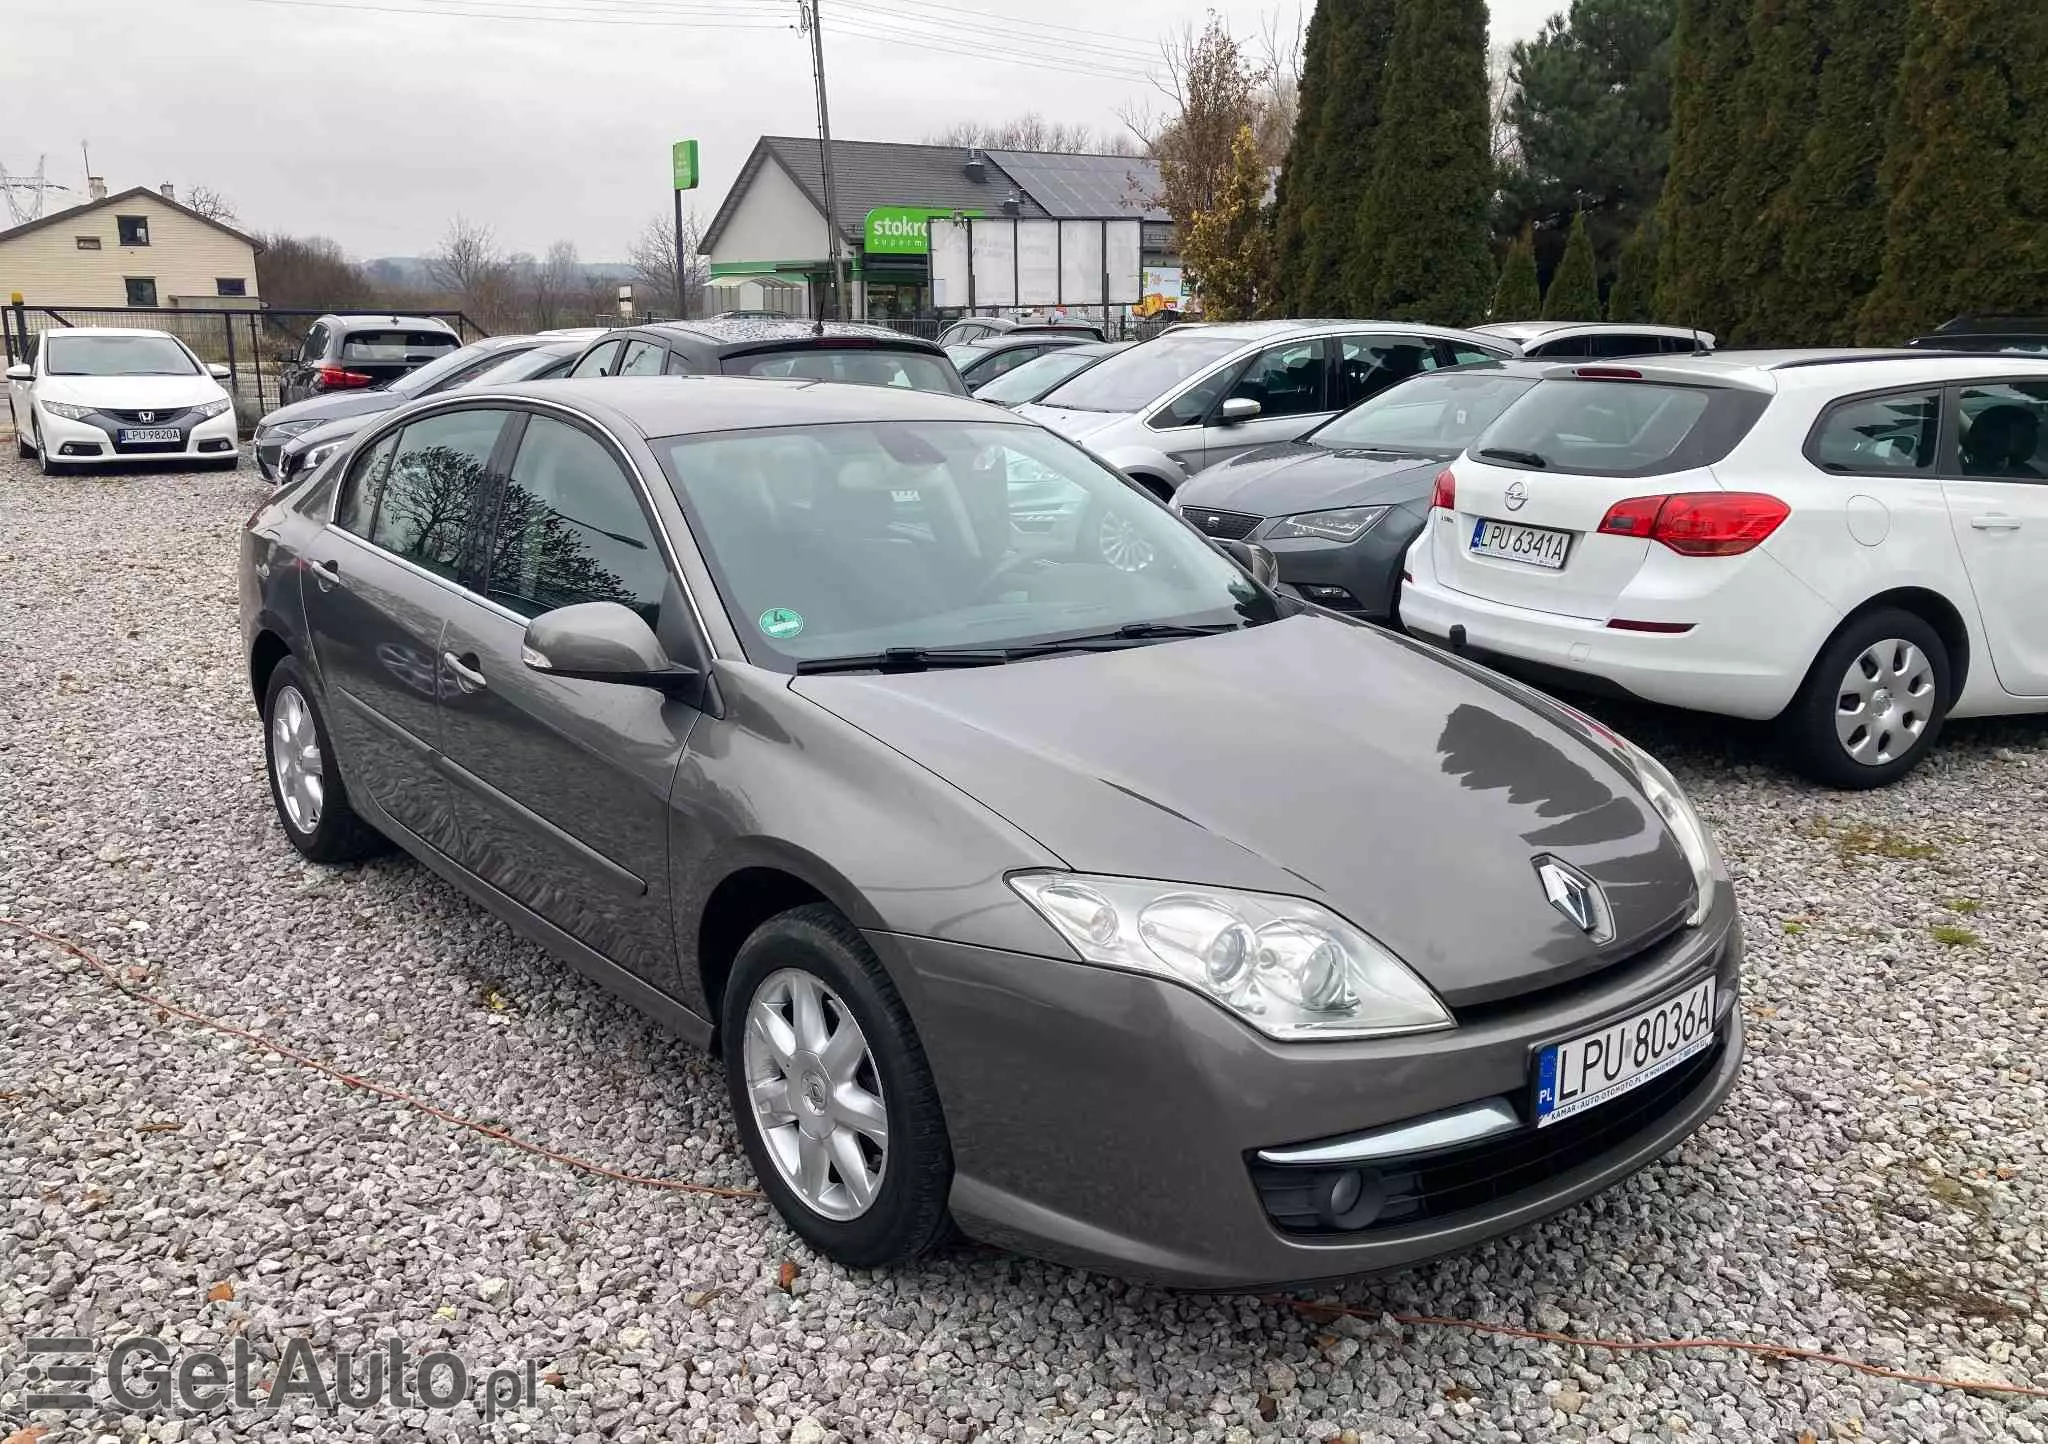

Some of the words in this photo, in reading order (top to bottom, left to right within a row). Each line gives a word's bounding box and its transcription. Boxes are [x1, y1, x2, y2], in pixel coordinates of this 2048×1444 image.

[126, 430, 146, 440] LPU
[148, 430, 179, 440] 9820A
[1480, 524, 1513, 550] LPU
[1513, 530, 1563, 560] 6341A
[1559, 1027, 1626, 1101] LPU
[1633, 985, 1709, 1068] 8036A
[1539, 1086, 1553, 1105] PL
